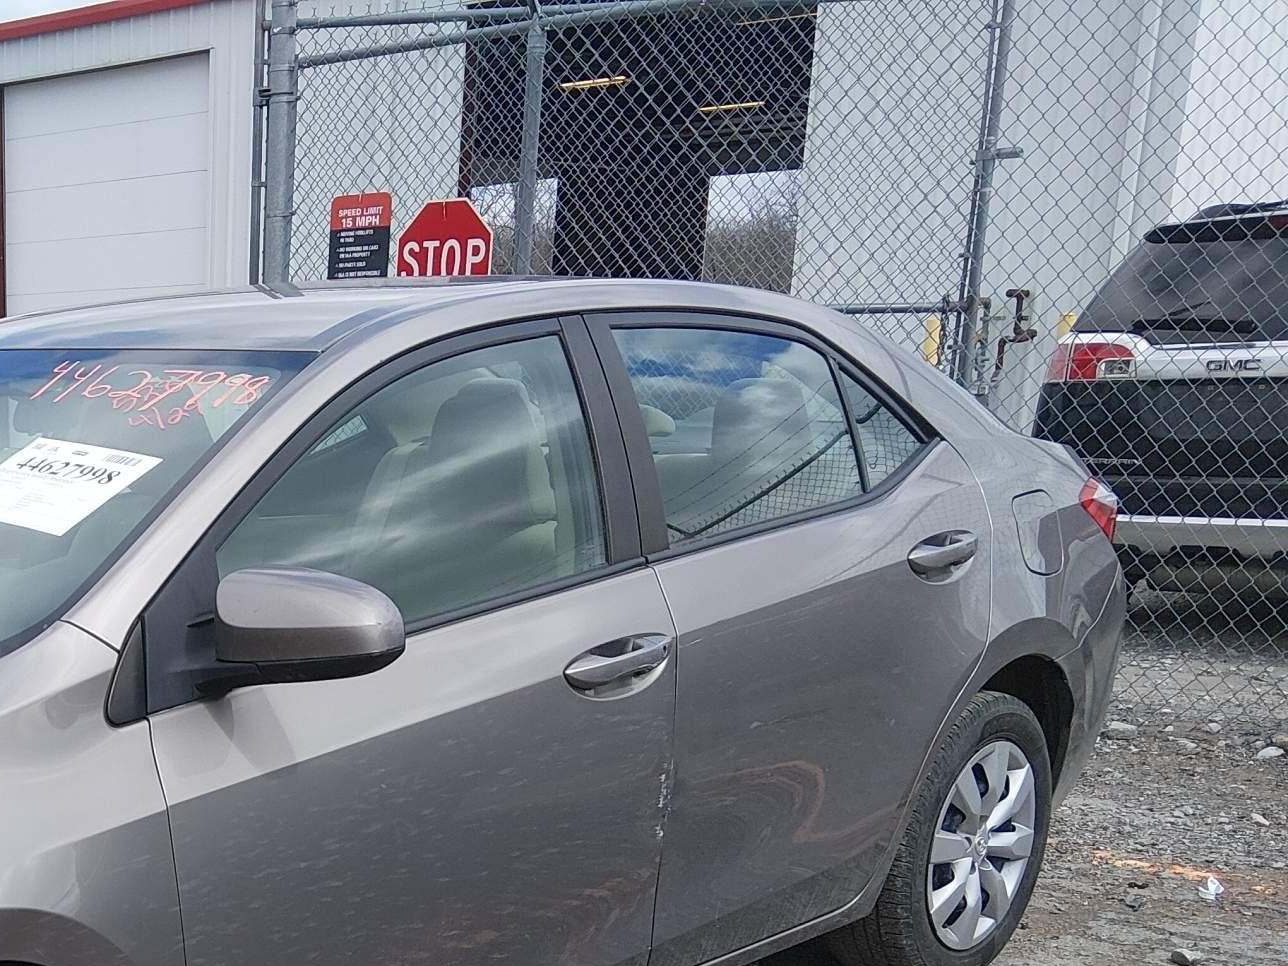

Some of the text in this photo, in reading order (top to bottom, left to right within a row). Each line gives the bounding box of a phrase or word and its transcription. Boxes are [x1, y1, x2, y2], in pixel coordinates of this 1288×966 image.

[338, 206, 383, 217] SPEED LIMIT
[341, 215, 379, 228] 15 MPH
[401, 238, 486, 276] STOP
[1206, 359, 1262, 371] GMC
[30, 360, 271, 411] 44627998
[16, 456, 121, 485] 44627998
